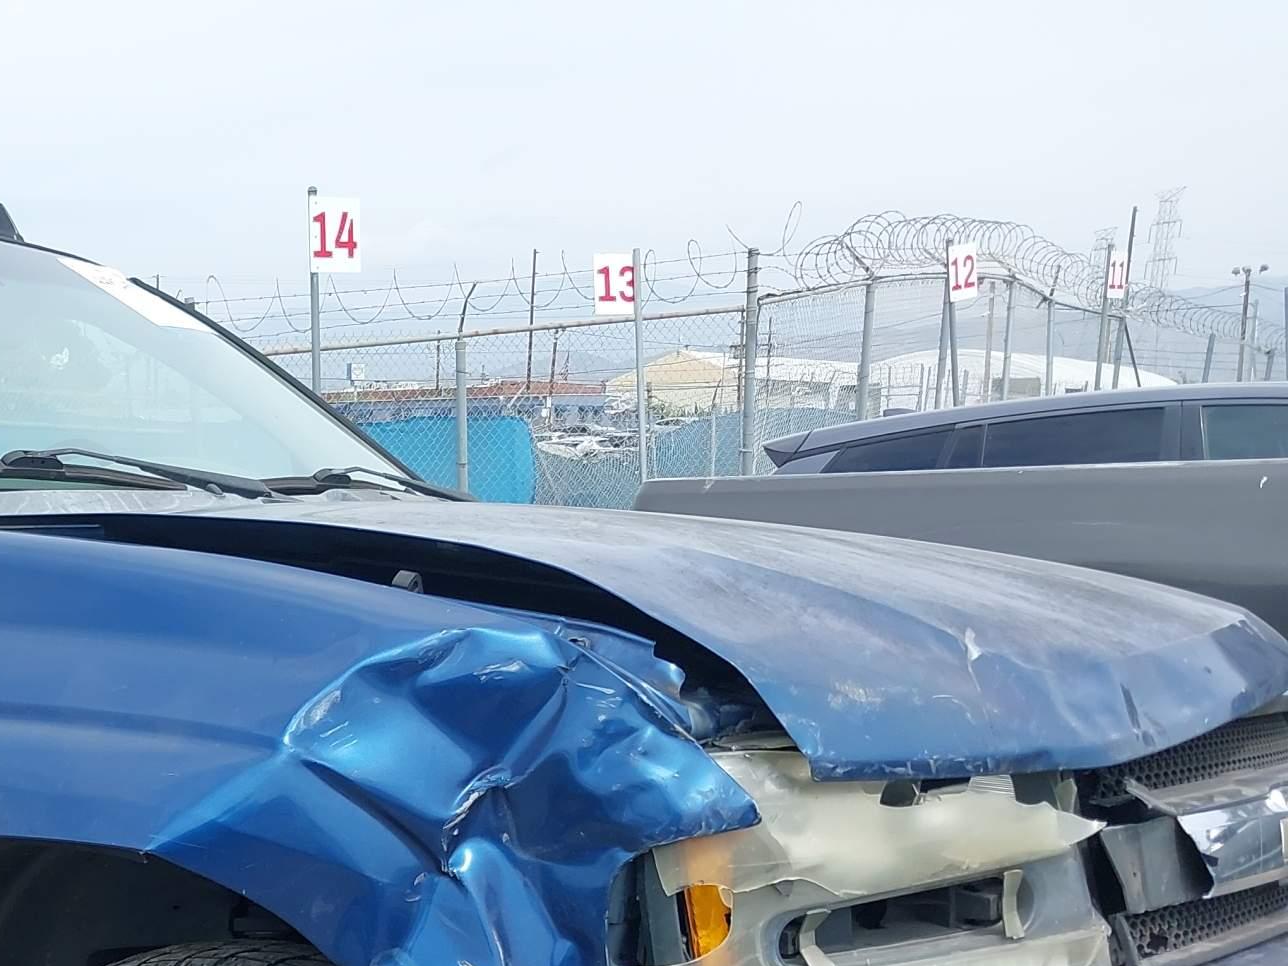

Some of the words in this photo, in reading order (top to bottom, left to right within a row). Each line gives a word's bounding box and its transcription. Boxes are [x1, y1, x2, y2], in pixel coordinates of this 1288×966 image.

[312, 211, 358, 259] 14
[597, 265, 635, 303] 13
[950, 253, 975, 292] 12
[1108, 260, 1125, 290] 11
